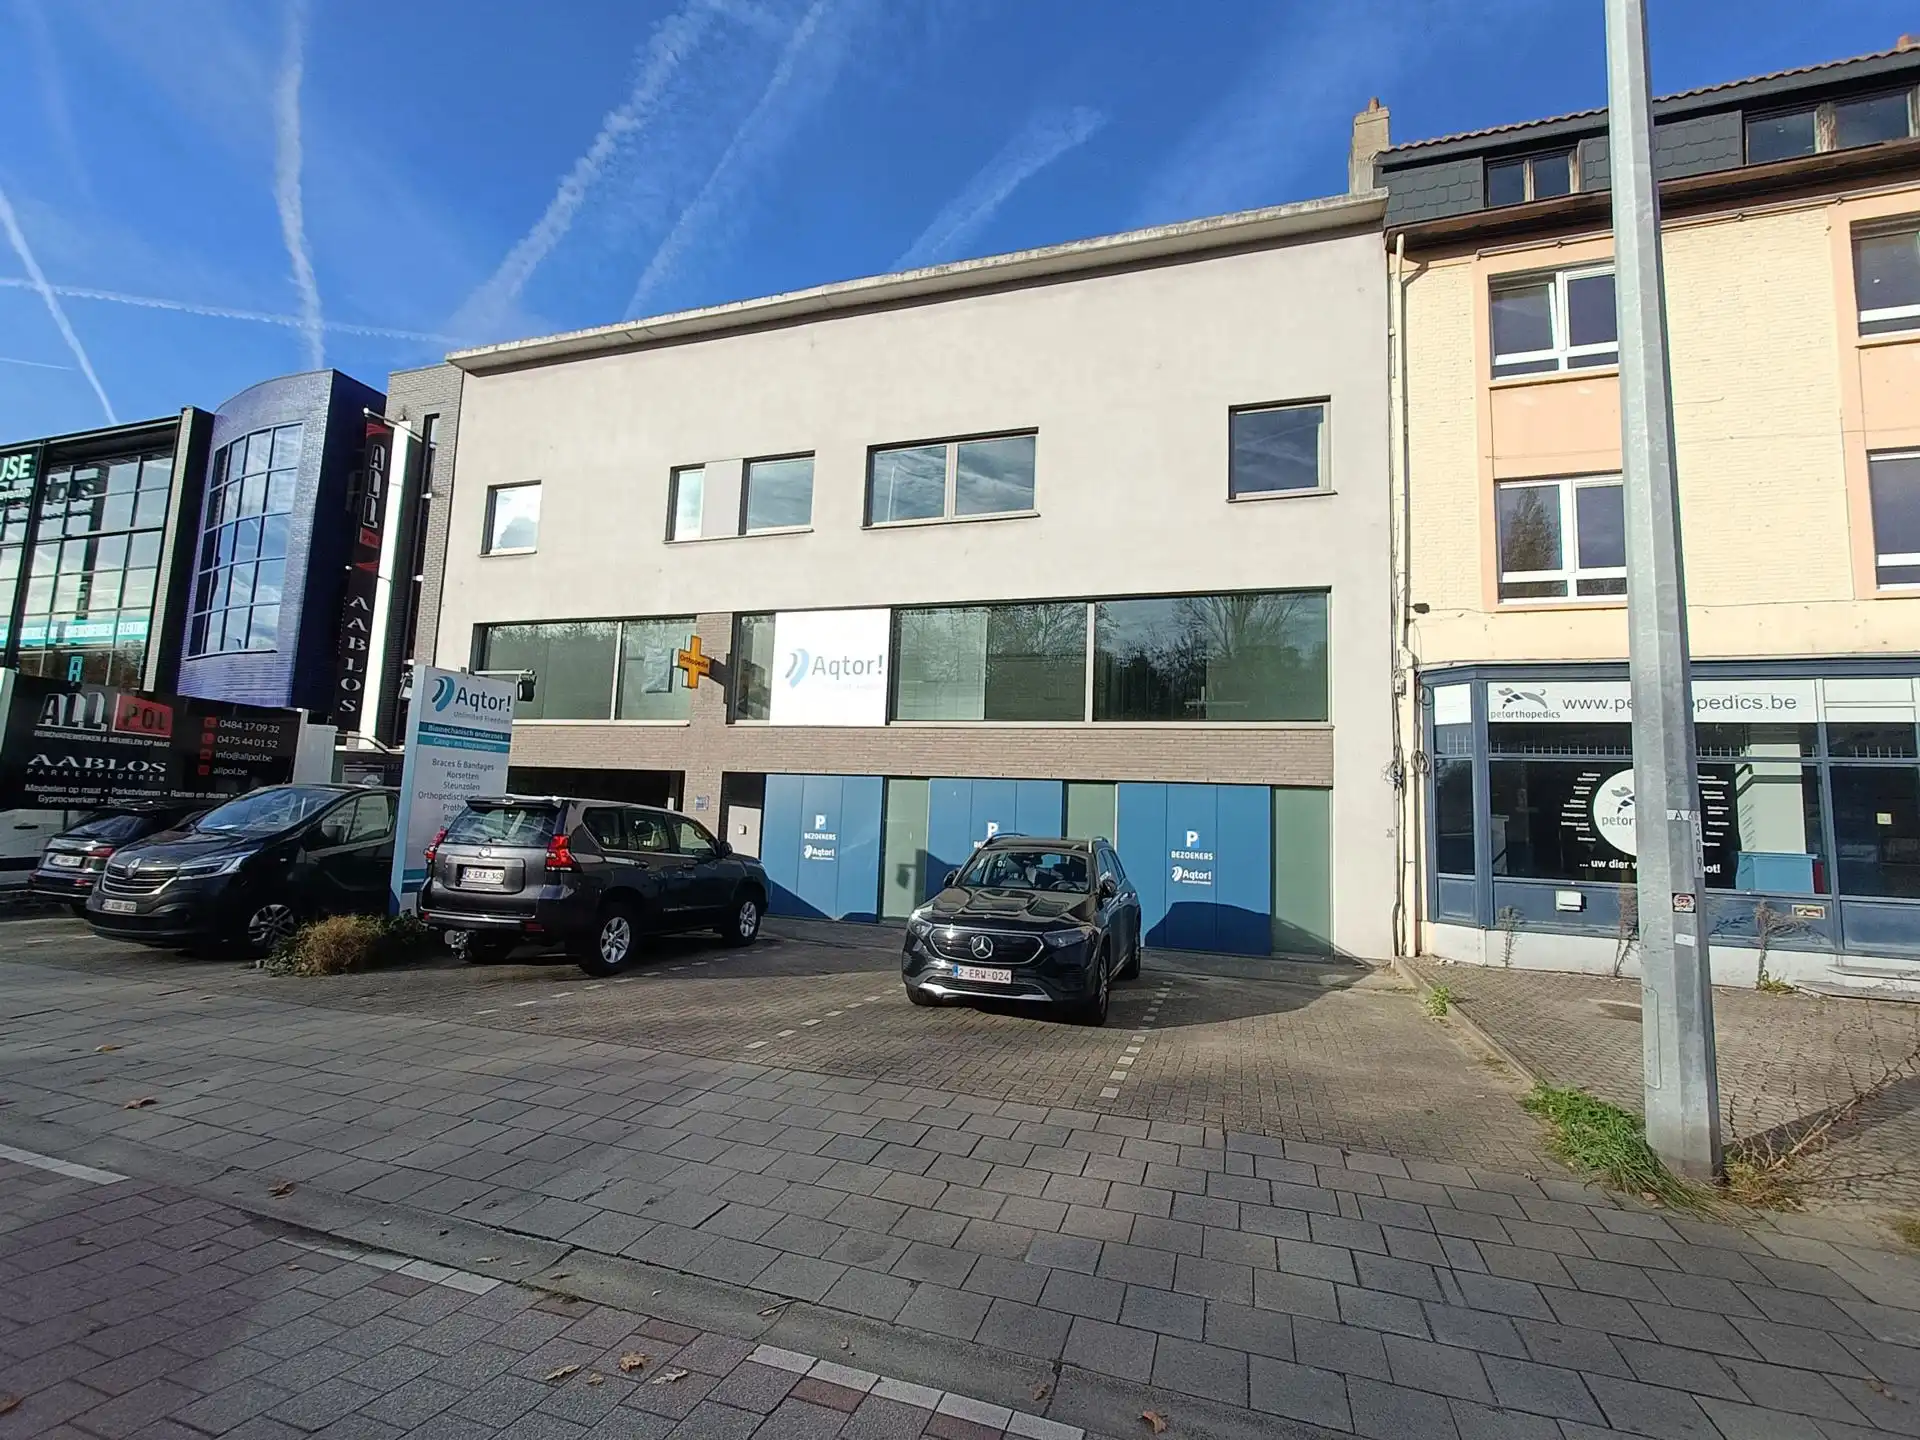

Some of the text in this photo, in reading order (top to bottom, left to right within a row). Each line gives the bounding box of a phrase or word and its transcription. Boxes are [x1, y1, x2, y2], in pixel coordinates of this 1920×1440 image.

[340, 596, 371, 712] AABLOS
[811, 655, 883, 680] Aqtor!
[454, 686, 512, 713] Aqtor!
[36, 692, 108, 732] ALL
[1490, 709, 1561, 719] petorthopedics
[219, 720, 280, 734] 0484 17 09 32
[217, 735, 241, 745] 0475
[242, 738, 253, 746] 44
[27, 753, 167, 773] AABLOS
[215, 751, 273, 763] info@allpol.be
[431, 758, 494, 772] Braces & Bandages
[26, 768, 166, 782] PARKETVLOEREN
[212, 767, 248, 776] allpol.be
[446, 771, 480, 781] Korsetten
[24, 783, 67, 793] Meubelen
[68, 787, 79, 795] op
[111, 787, 161, 797] Parketvloeren
[170, 789, 195, 798] Ramen
[442, 782, 481, 791] Steunzolen
[442, 803, 467, 812] Prothe
[1601, 815, 1636, 826] petor
[812, 847, 835, 857] Aqtor!
[1171, 850, 1213, 860] BEZOEKERS
[1591, 860, 1606, 868] uw
[1609, 859, 1629, 869] dier
[1182, 869, 1212, 881] Aqtor!
